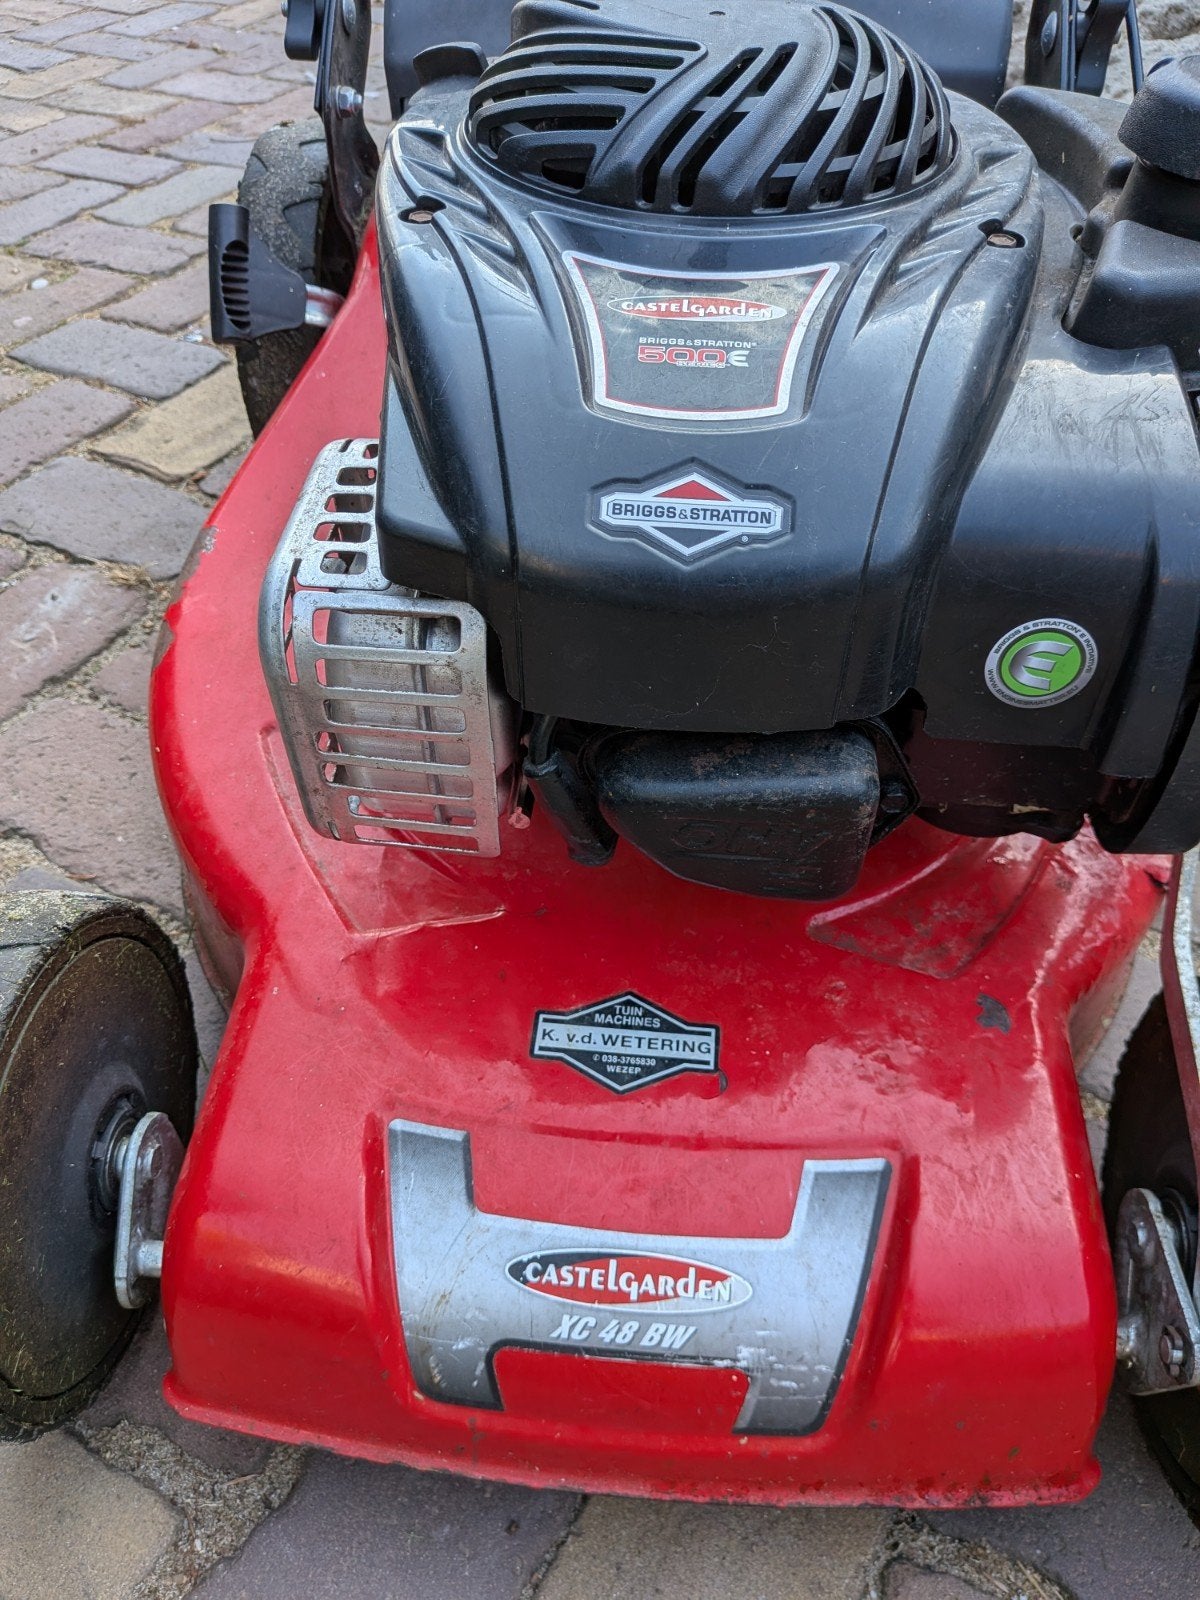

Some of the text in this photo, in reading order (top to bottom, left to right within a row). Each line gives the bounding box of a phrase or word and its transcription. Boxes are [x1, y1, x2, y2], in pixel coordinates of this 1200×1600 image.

[614, 1005, 643, 1016] TUIN
[594, 1013, 661, 1028] MACHINES
[541, 1028, 712, 1054] K. v.d. WETERING
[606, 1065, 642, 1075] WEZEP
[550, 1314, 697, 1350] XC 48 BW
